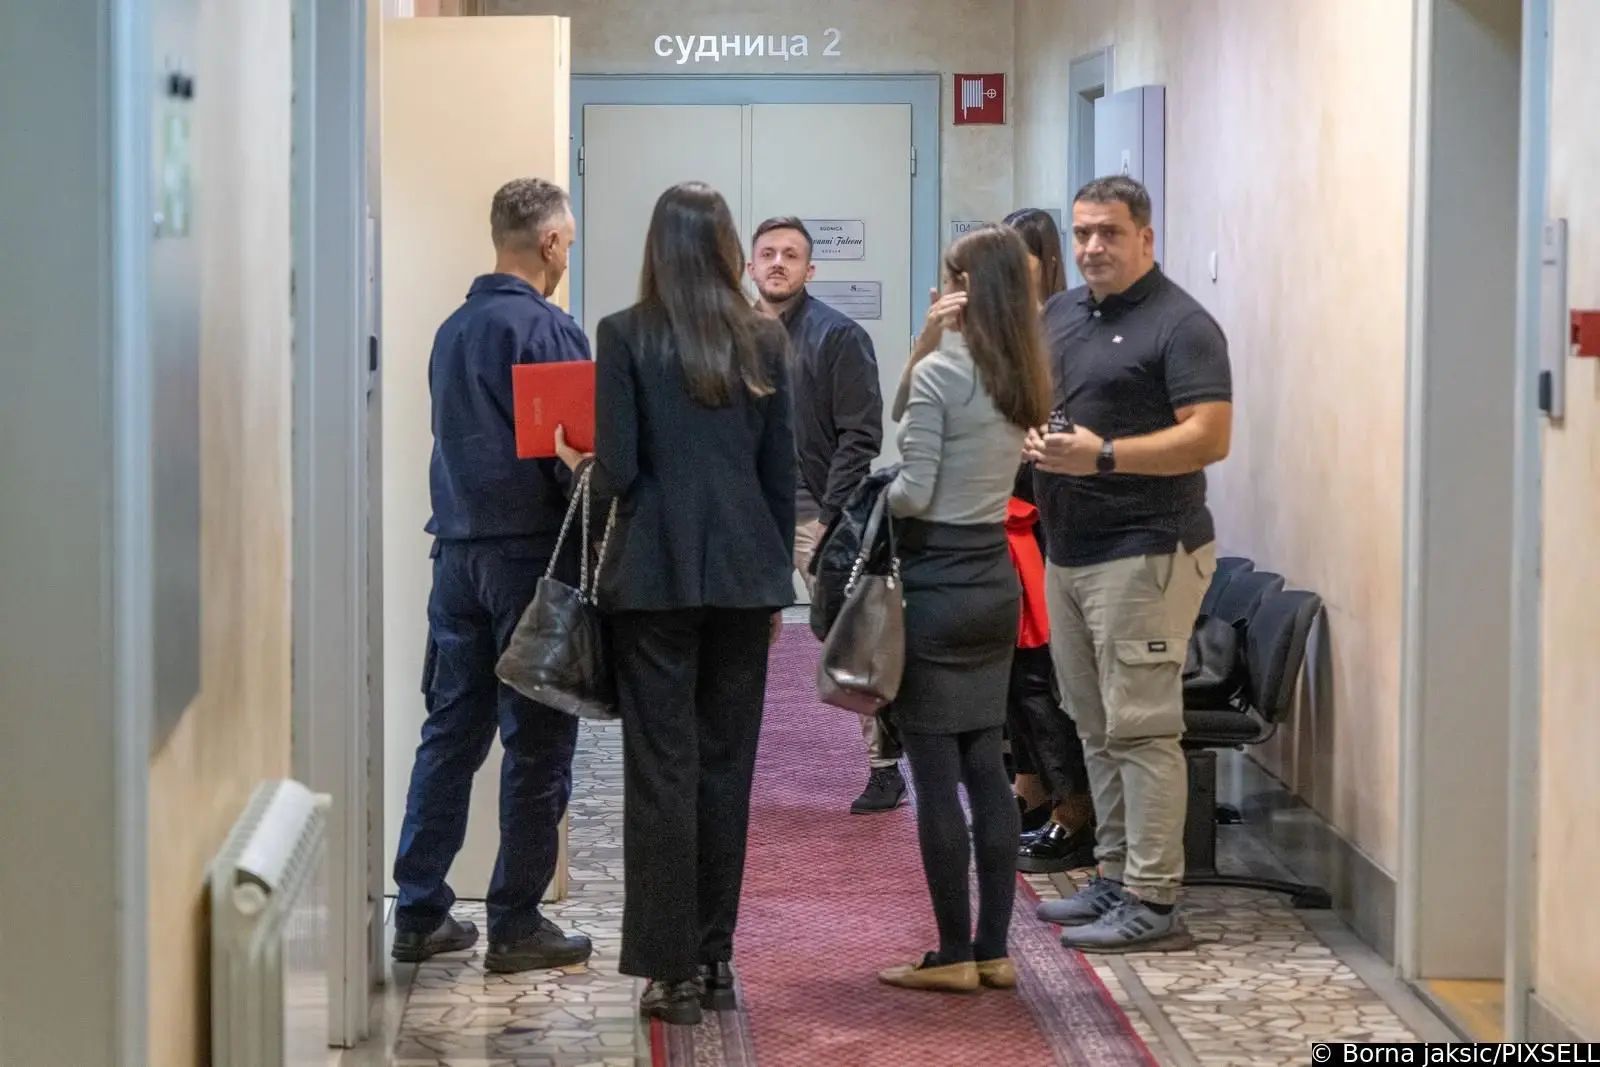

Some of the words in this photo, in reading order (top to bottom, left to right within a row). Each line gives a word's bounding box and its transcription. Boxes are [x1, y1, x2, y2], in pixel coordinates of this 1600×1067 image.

[654, 34, 808, 65] судница
[822, 27, 841, 56] 2
[834, 236, 863, 247] Falcone
